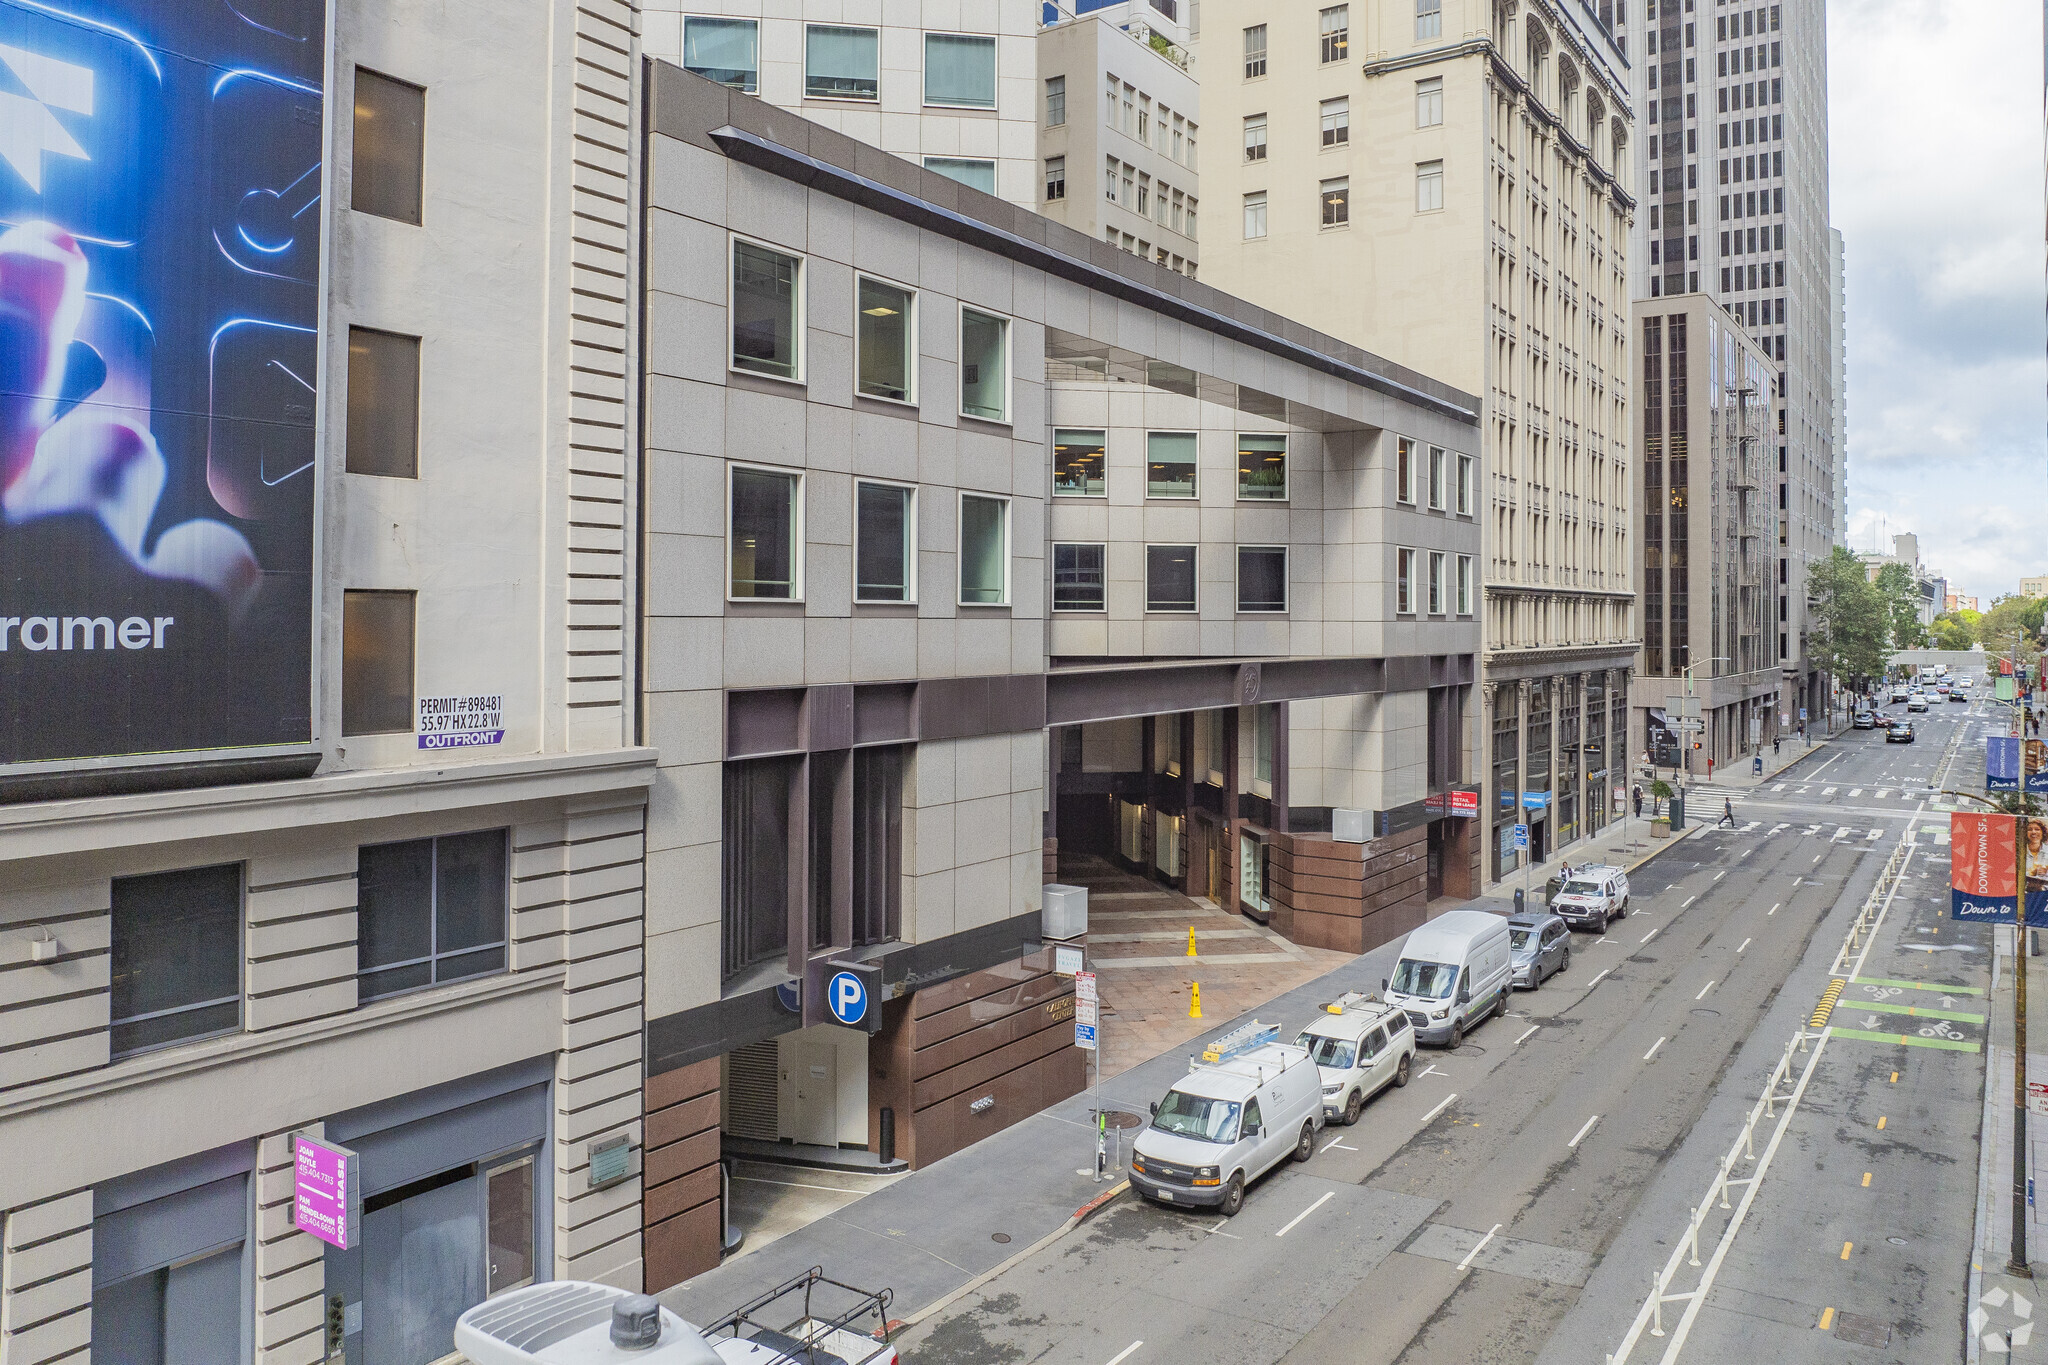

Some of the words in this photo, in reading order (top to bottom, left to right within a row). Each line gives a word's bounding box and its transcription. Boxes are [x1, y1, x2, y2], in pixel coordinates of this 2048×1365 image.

[420, 696, 501, 714] PERMIT#898481
[425, 731, 498, 748] OUTFRONT
[1990, 780, 2009, 788] Down
[1978, 821, 1988, 832] SF
[1978, 834, 1988, 894] DOWNTOWN
[1960, 902, 1997, 915] Down
[2000, 905, 2011, 914] to
[839, 977, 861, 1016] P
[299, 1145, 314, 1158] JOAN
[299, 1194, 311, 1206] PAM
[299, 1203, 336, 1226] MENDELSOHN
